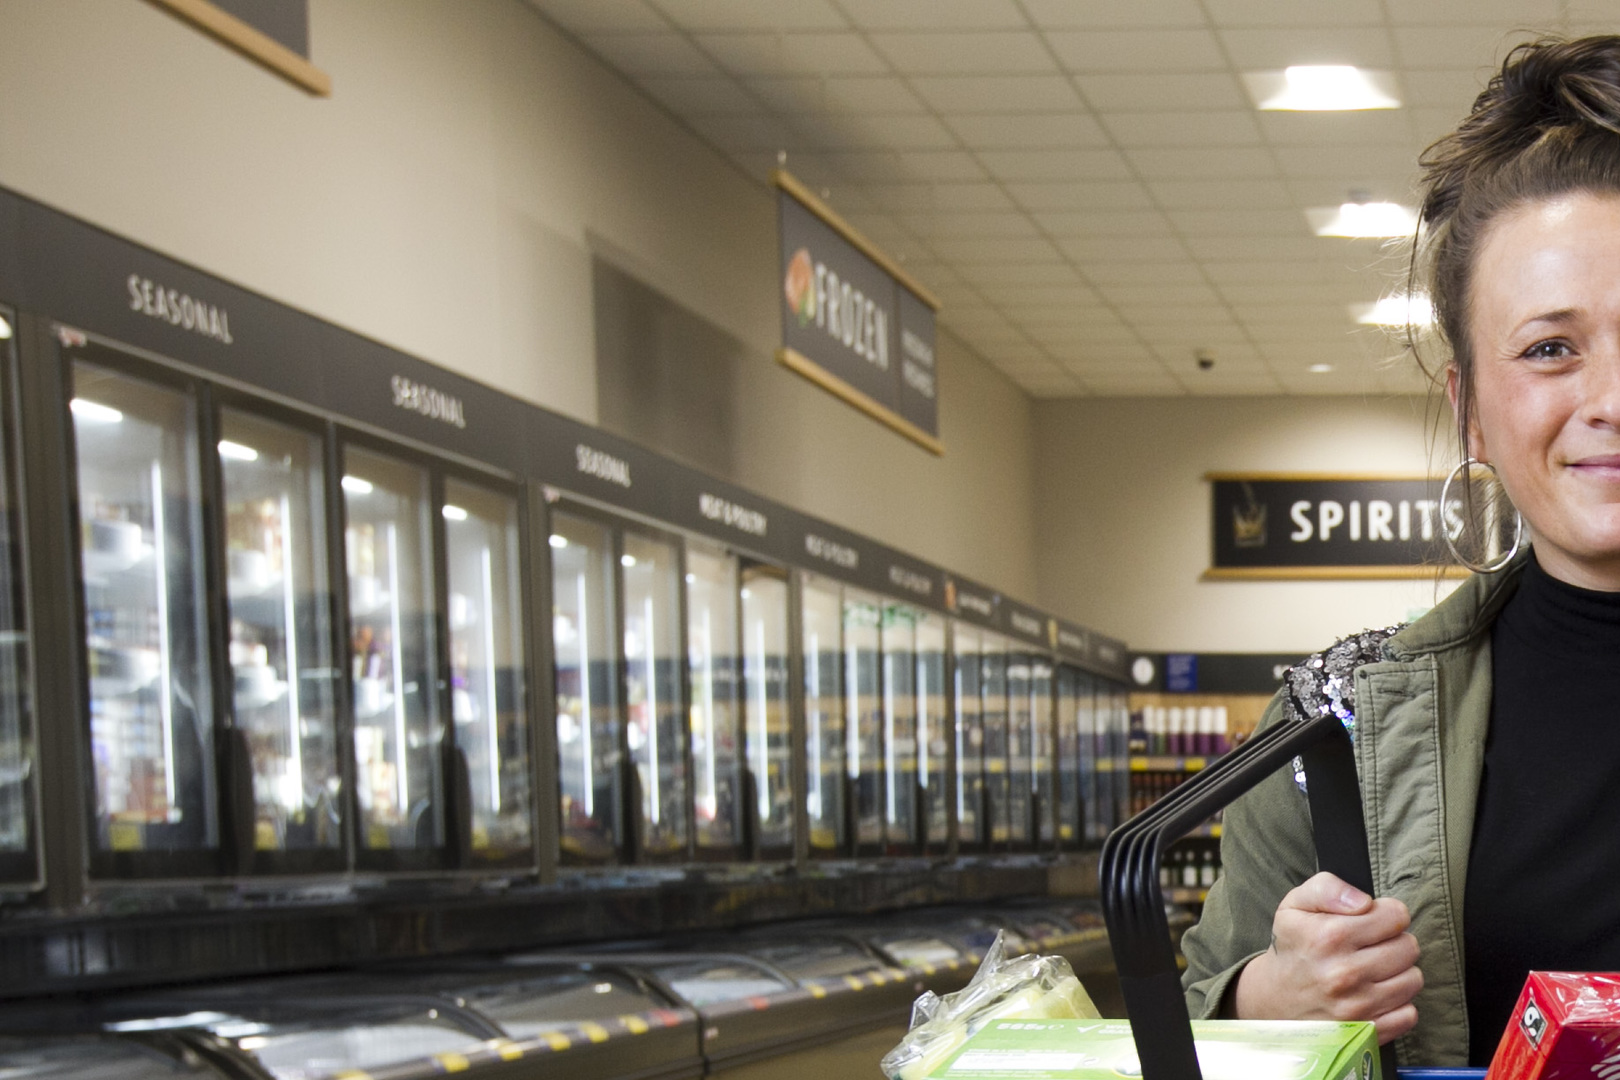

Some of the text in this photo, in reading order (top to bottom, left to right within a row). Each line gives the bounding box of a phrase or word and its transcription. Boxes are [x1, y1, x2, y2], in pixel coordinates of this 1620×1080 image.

[127, 274, 233, 345] SEASONAL
[815, 263, 889, 370] FROZEN
[390, 374, 466, 429] SEASONAL
[1290, 499, 1465, 542] SPIRITS
